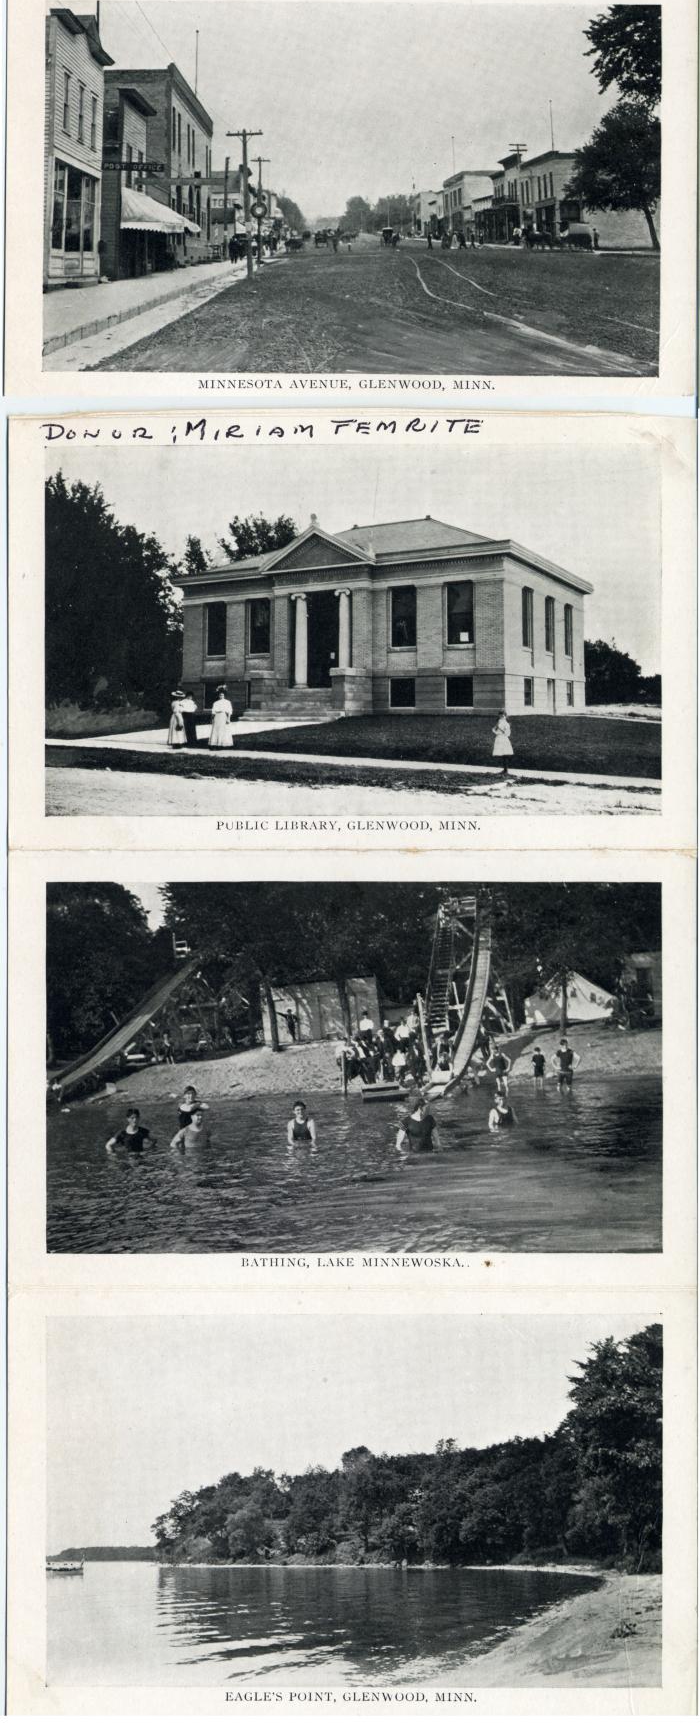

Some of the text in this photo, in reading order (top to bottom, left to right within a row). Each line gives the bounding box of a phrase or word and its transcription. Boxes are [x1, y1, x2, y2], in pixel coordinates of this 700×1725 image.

[198, 379, 496, 391] MINNESOTA AVENUE, GLENWOOD, MINN.
[184, 418, 315, 441] MIRIAM
[330, 417, 484, 436] FEMRITE
[216, 820, 481, 832] PUBLIC LIBRARY, GLENWOOD, MINN.
[241, 1257, 310, 1269] BATHING,
[317, 1257, 355, 1267] LAKE
[225, 1691, 477, 1703] EAGLE'S POINT, GLENWOOD, MINN.
